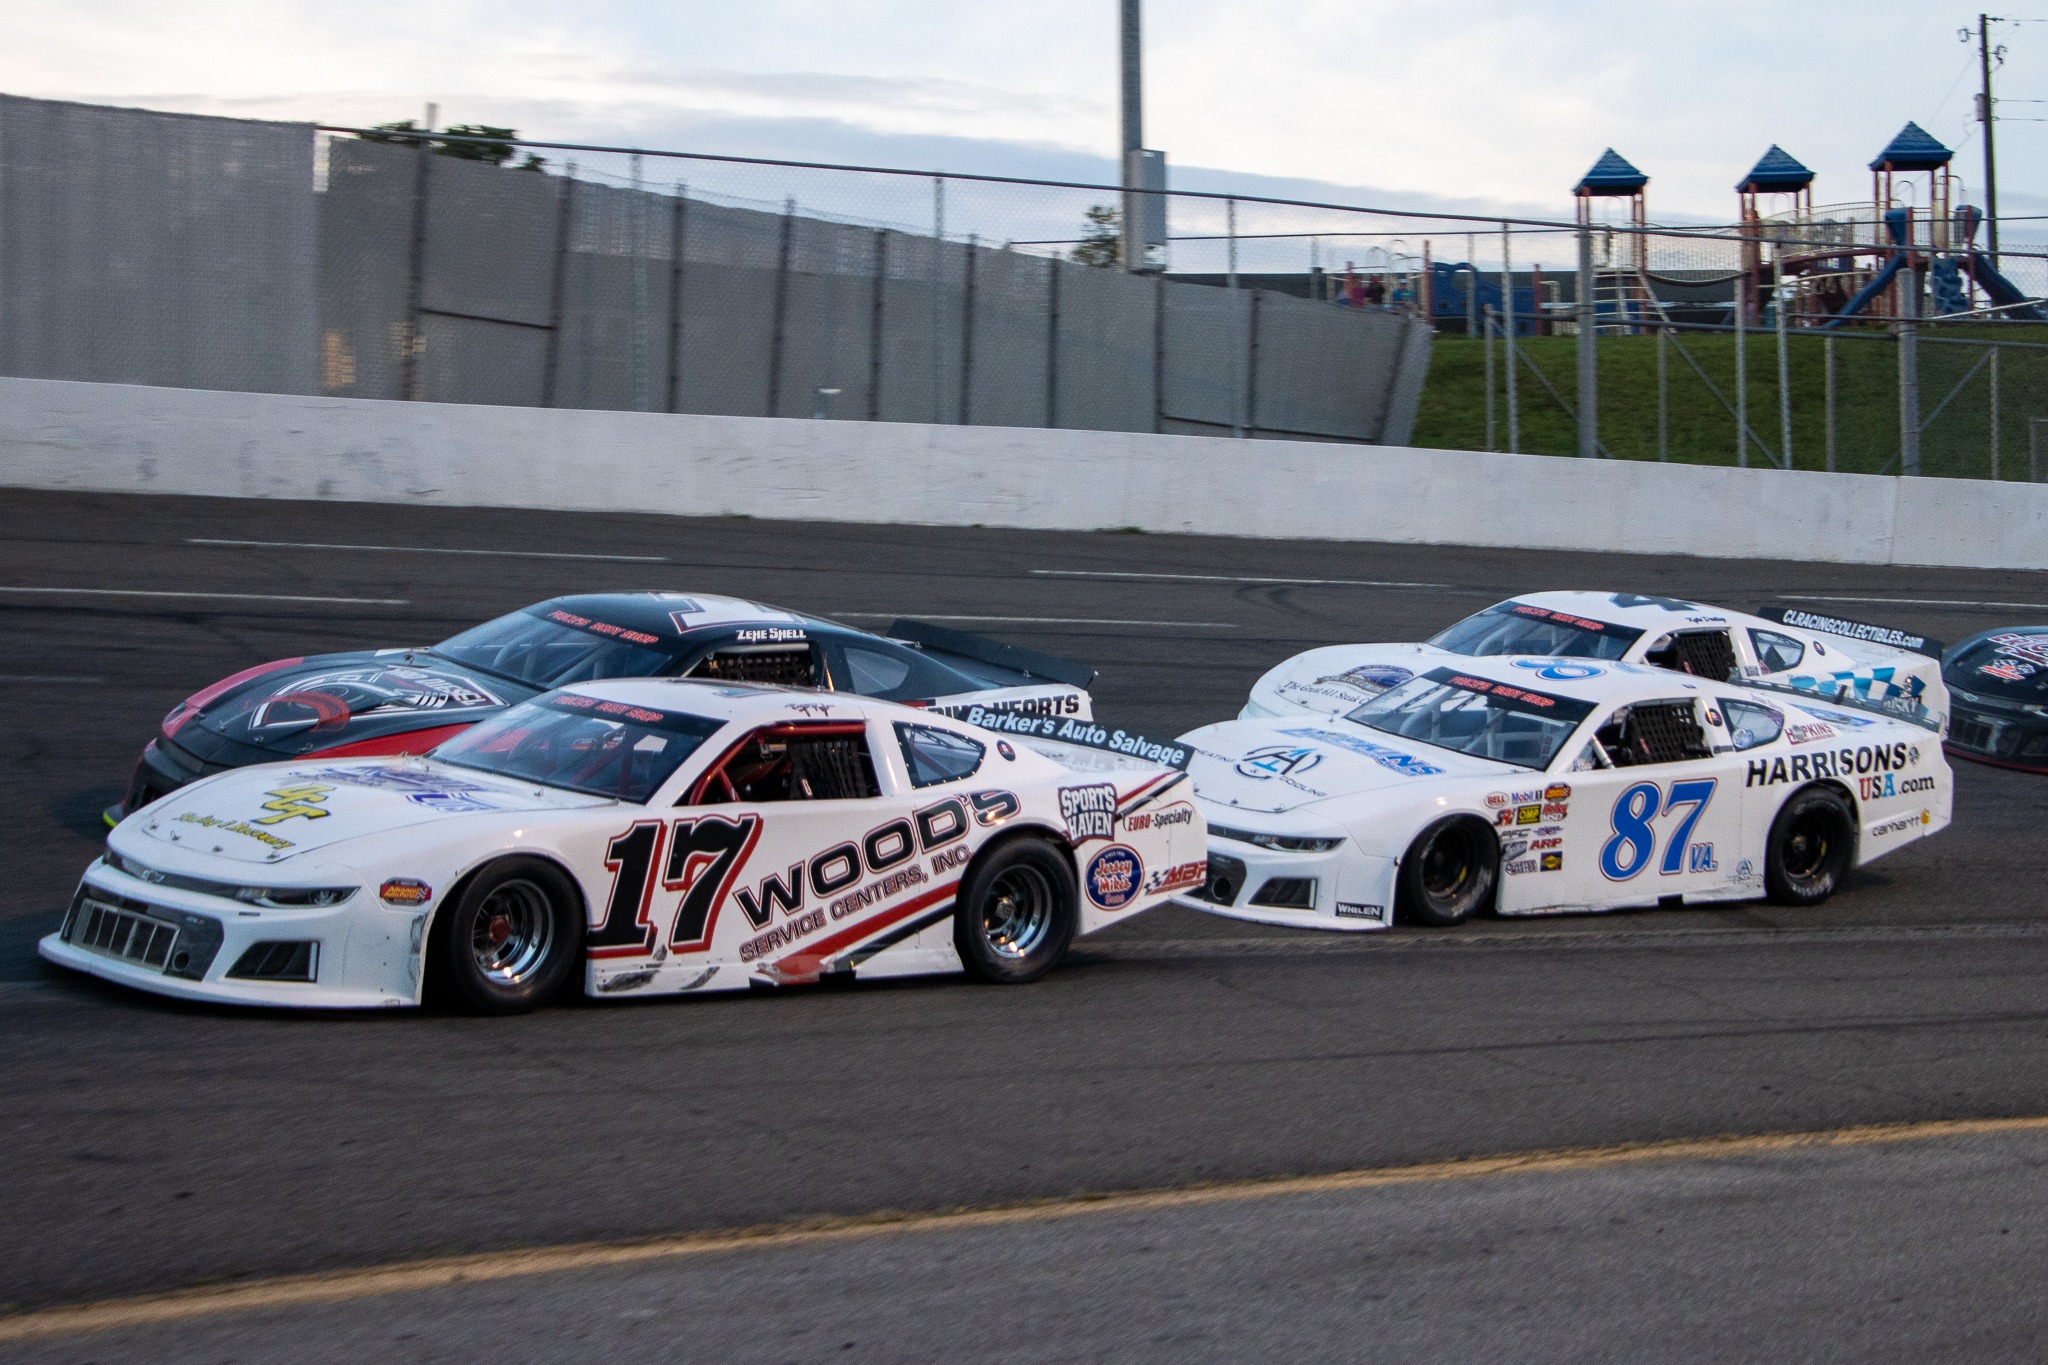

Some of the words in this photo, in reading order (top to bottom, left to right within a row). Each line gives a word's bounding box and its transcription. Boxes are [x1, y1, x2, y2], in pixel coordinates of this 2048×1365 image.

[619, 630, 659, 644] SHOP
[769, 627, 806, 642] SHELL
[1783, 609, 1924, 648] CLRACINGCOLLECTIBLES.com
[967, 705, 1056, 735] Barker's
[1057, 719, 1107, 744] Auto
[1109, 730, 1184, 767] Salvage
[1745, 742, 1907, 787] HARRISONS
[1061, 785, 1116, 818] SPORTS
[1519, 810, 1539, 820] OMP
[1068, 811, 1112, 842] HAVEN
[1127, 808, 1193, 832] EURO-Specialty
[1599, 777, 1718, 882] 87
[1871, 815, 1921, 837] carhartt
[1530, 837, 1563, 850] ARP
[732, 789, 1021, 931] WOOD'S
[1094, 858, 1132, 881] Jersey
[586, 812, 764, 959] 17
[739, 907, 828, 963] SERVICE
[830, 863, 929, 921] CENTERS,
